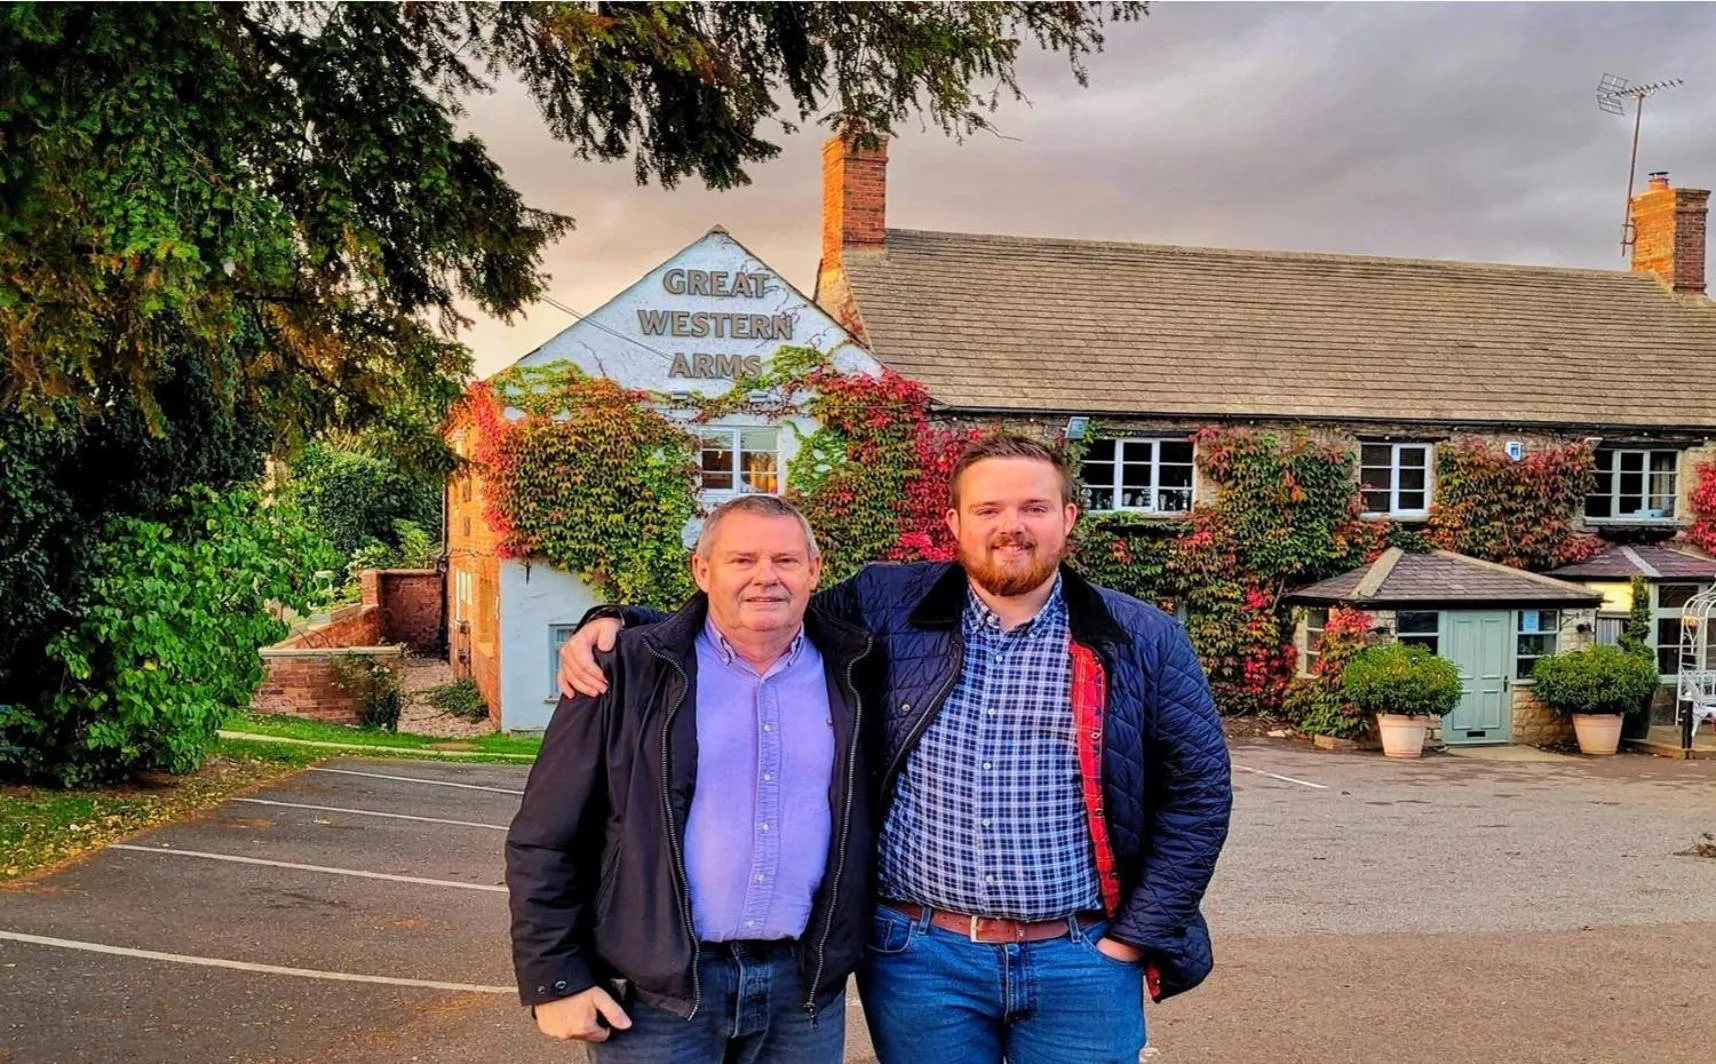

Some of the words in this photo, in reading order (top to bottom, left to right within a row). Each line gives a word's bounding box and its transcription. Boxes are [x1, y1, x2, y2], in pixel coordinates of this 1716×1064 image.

[663, 269, 771, 298] GREAT
[637, 309, 793, 340] WESTERN
[668, 352, 762, 379] ARMS
